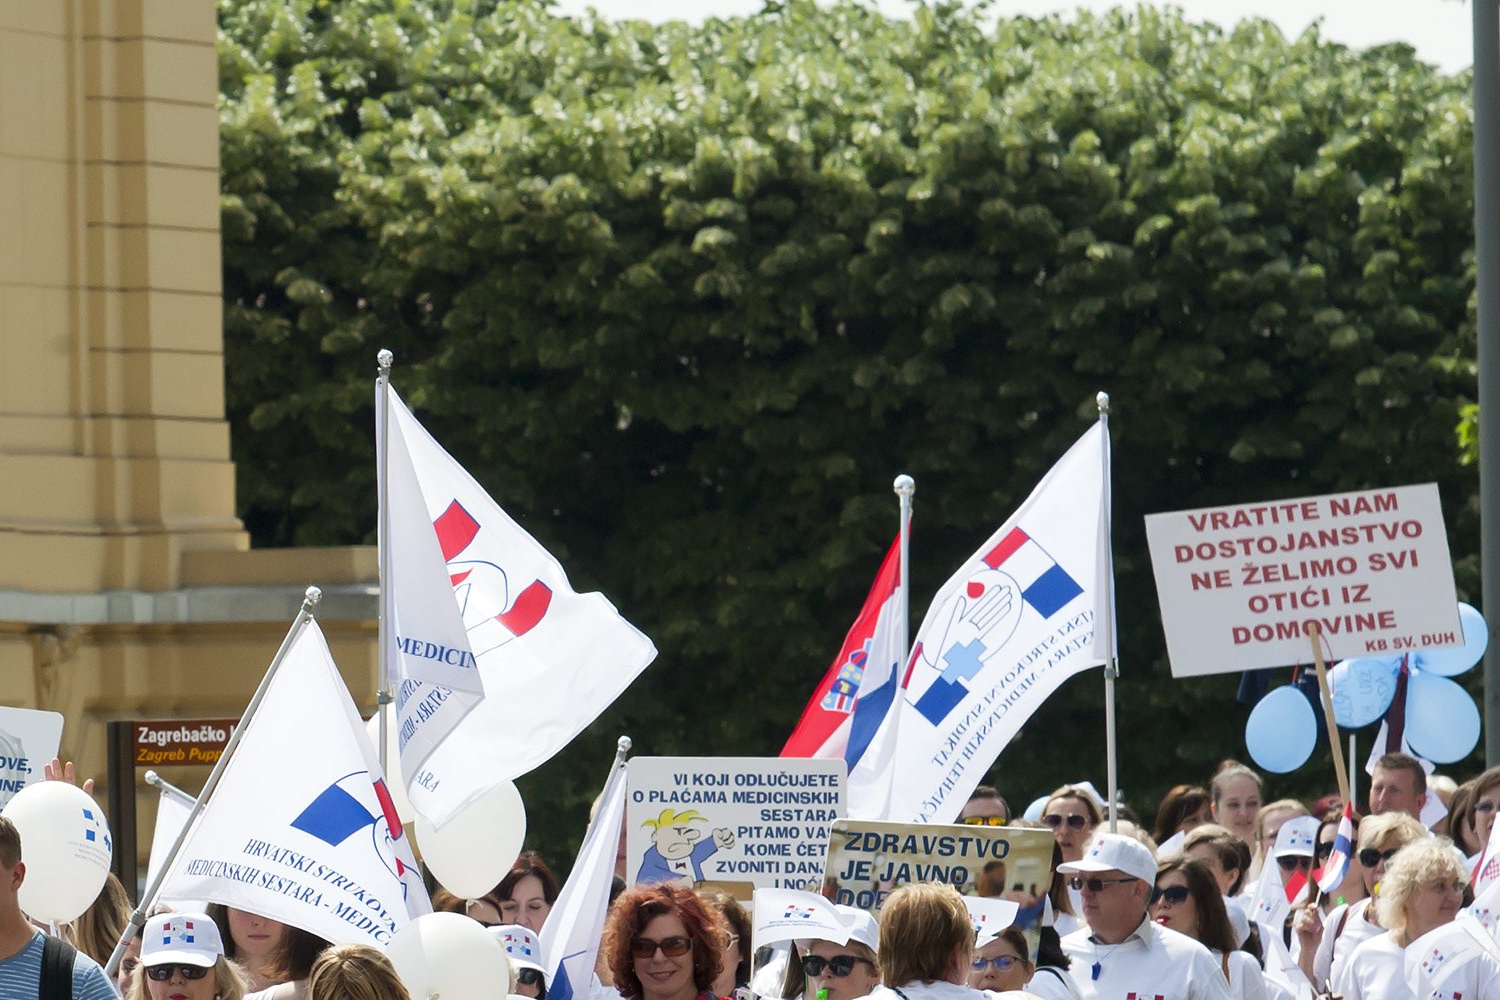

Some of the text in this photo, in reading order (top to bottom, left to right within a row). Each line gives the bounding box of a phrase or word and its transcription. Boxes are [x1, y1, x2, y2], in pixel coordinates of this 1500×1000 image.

[1188, 492, 1399, 533] VRATITE NAM
[1174, 520, 1423, 563] DOSTOJANSTVO
[1190, 549, 1419, 590] NE ŽELIMO SVI
[1248, 584, 1372, 614] OTIĆI IZ
[1232, 611, 1396, 645] DOMOVINE
[1365, 631, 1456, 652] KB SV. DUH
[138, 725, 226, 746] Zagrebačko
[137, 748, 186, 763] Zagreb
[674, 771, 839, 787] VI KOJI ODLUČUJETE
[633, 788, 839, 804] O PLAĆAMA MEDICINSKIH
[760, 809, 838, 822] SESTARA
[738, 826, 800, 839] PITAMO
[242, 838, 316, 875] HRVATSKI
[744, 844, 791, 856] KOME
[844, 832, 1010, 859] ZDRAVSTVO
[716, 861, 780, 874] ZVONITI
[840, 860, 968, 885] JE JAVNO
[183, 859, 259, 885] MEDICINSKIH
[258, 872, 326, 908] SESTARA
[332, 901, 391, 946] MEDIC
